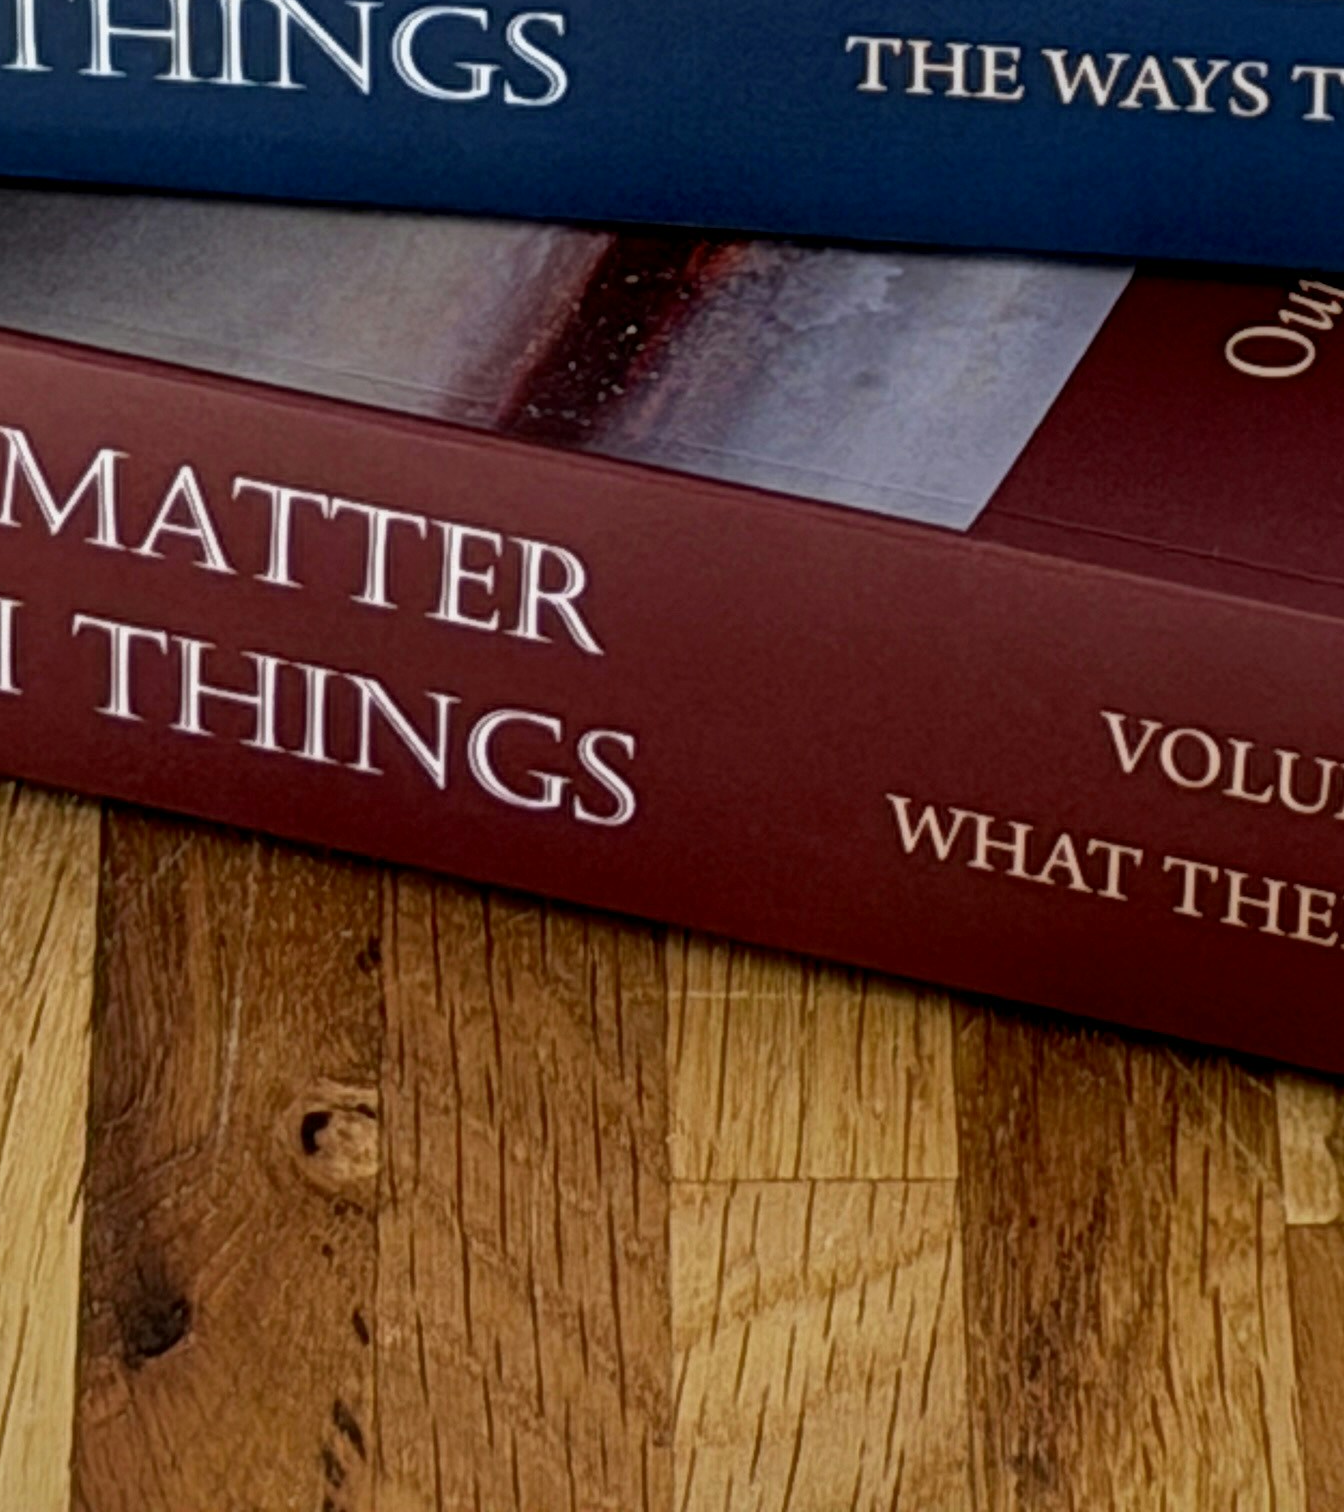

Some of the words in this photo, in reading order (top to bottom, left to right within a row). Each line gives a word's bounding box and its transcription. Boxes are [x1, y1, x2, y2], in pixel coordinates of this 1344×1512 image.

[845, 36, 1025, 100] THE
[1041, 49, 1269, 117] WAYS
[72, 614, 636, 825] THINGS
[886, 793, 1143, 900] WHAT
